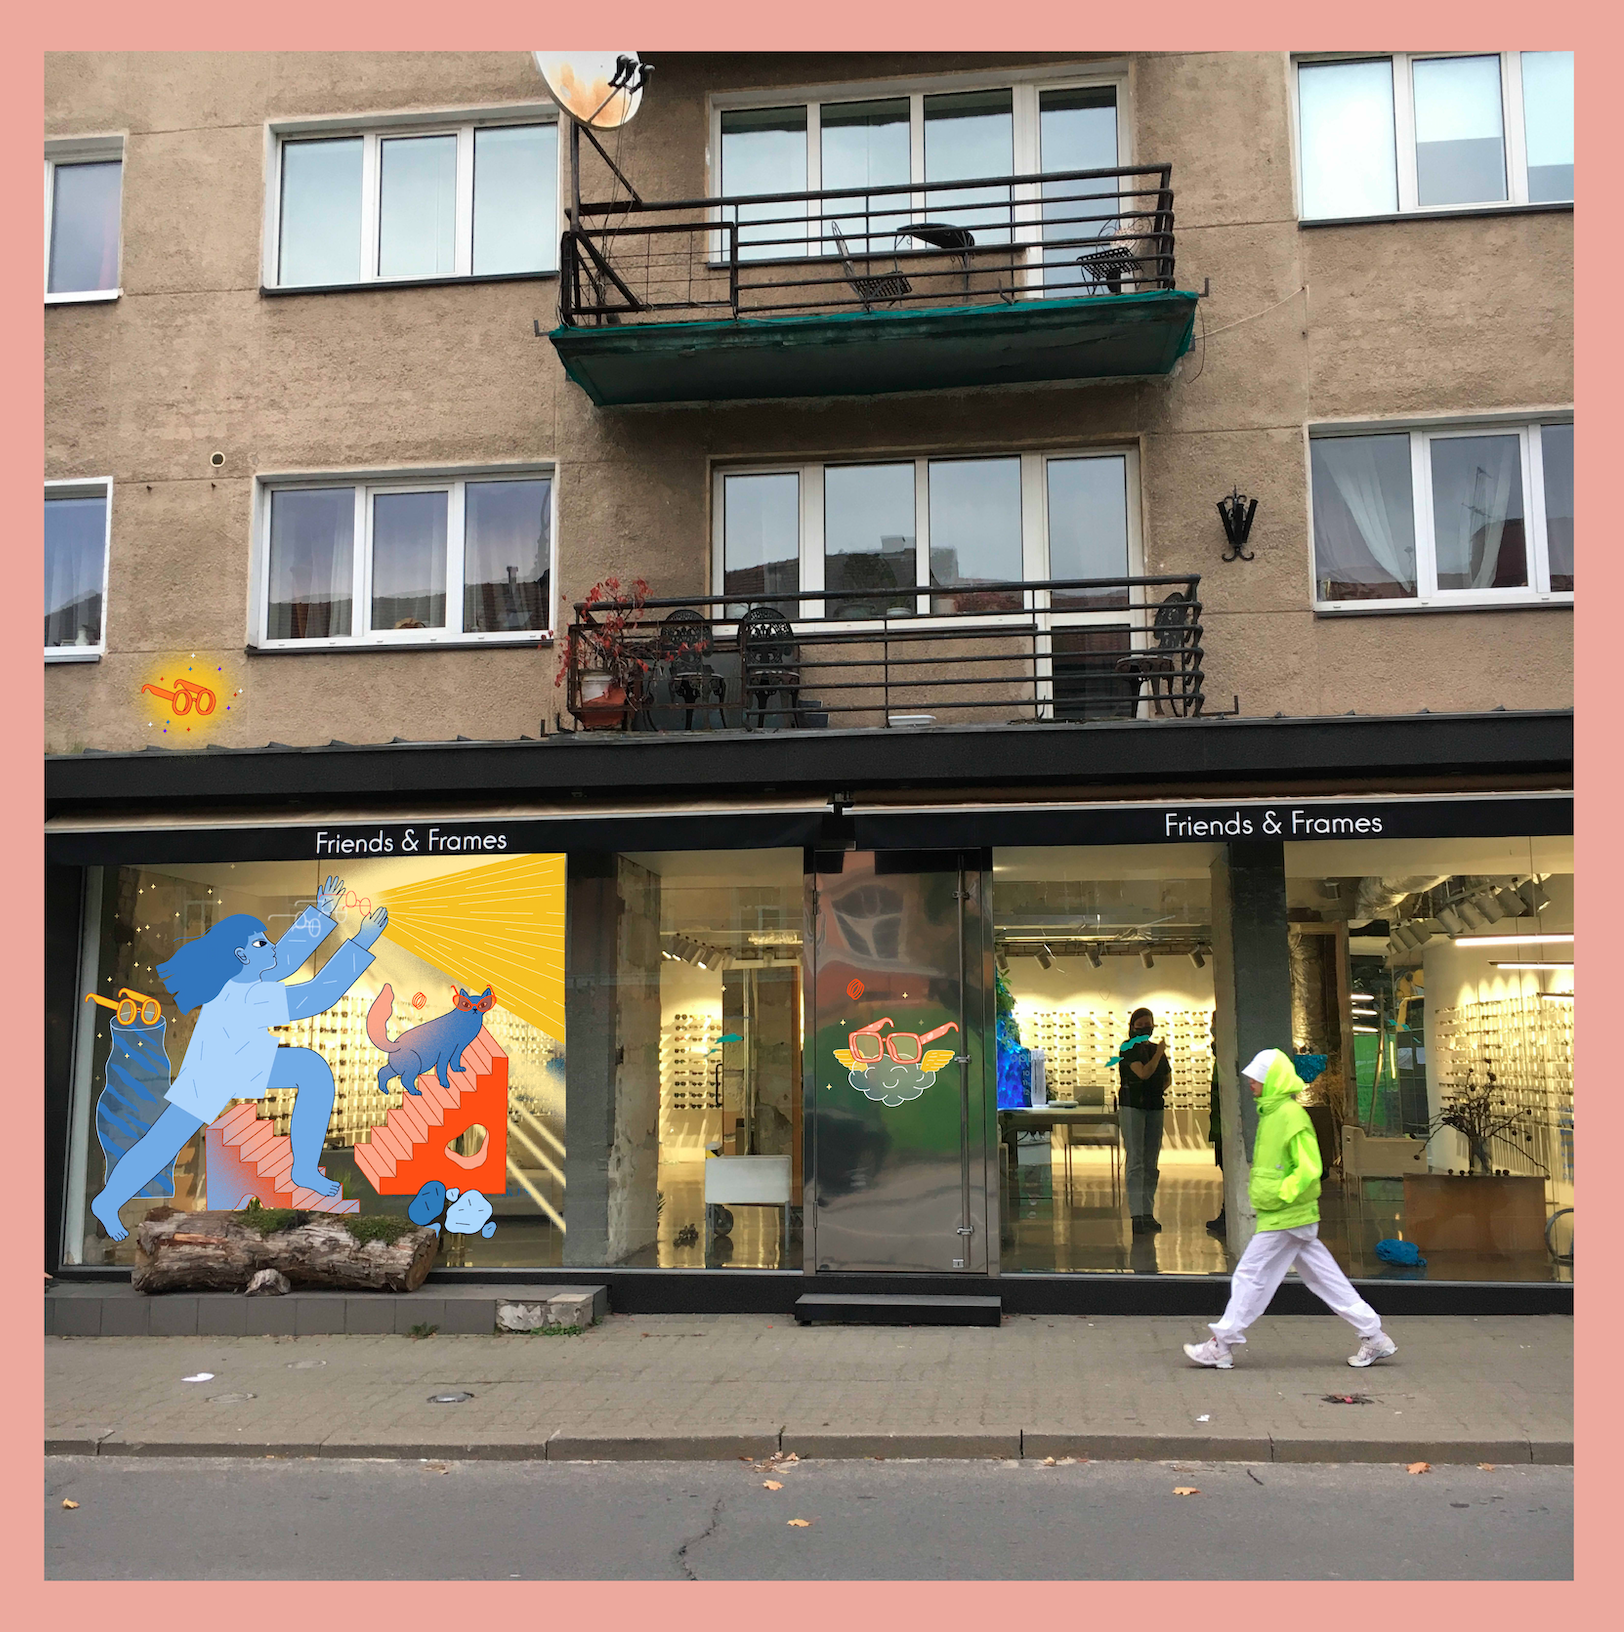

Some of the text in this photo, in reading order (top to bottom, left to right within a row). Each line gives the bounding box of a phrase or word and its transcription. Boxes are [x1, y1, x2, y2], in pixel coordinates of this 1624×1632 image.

[1165, 810, 1383, 837] Friends & Frames
[316, 828, 508, 854] Friends & Frames
